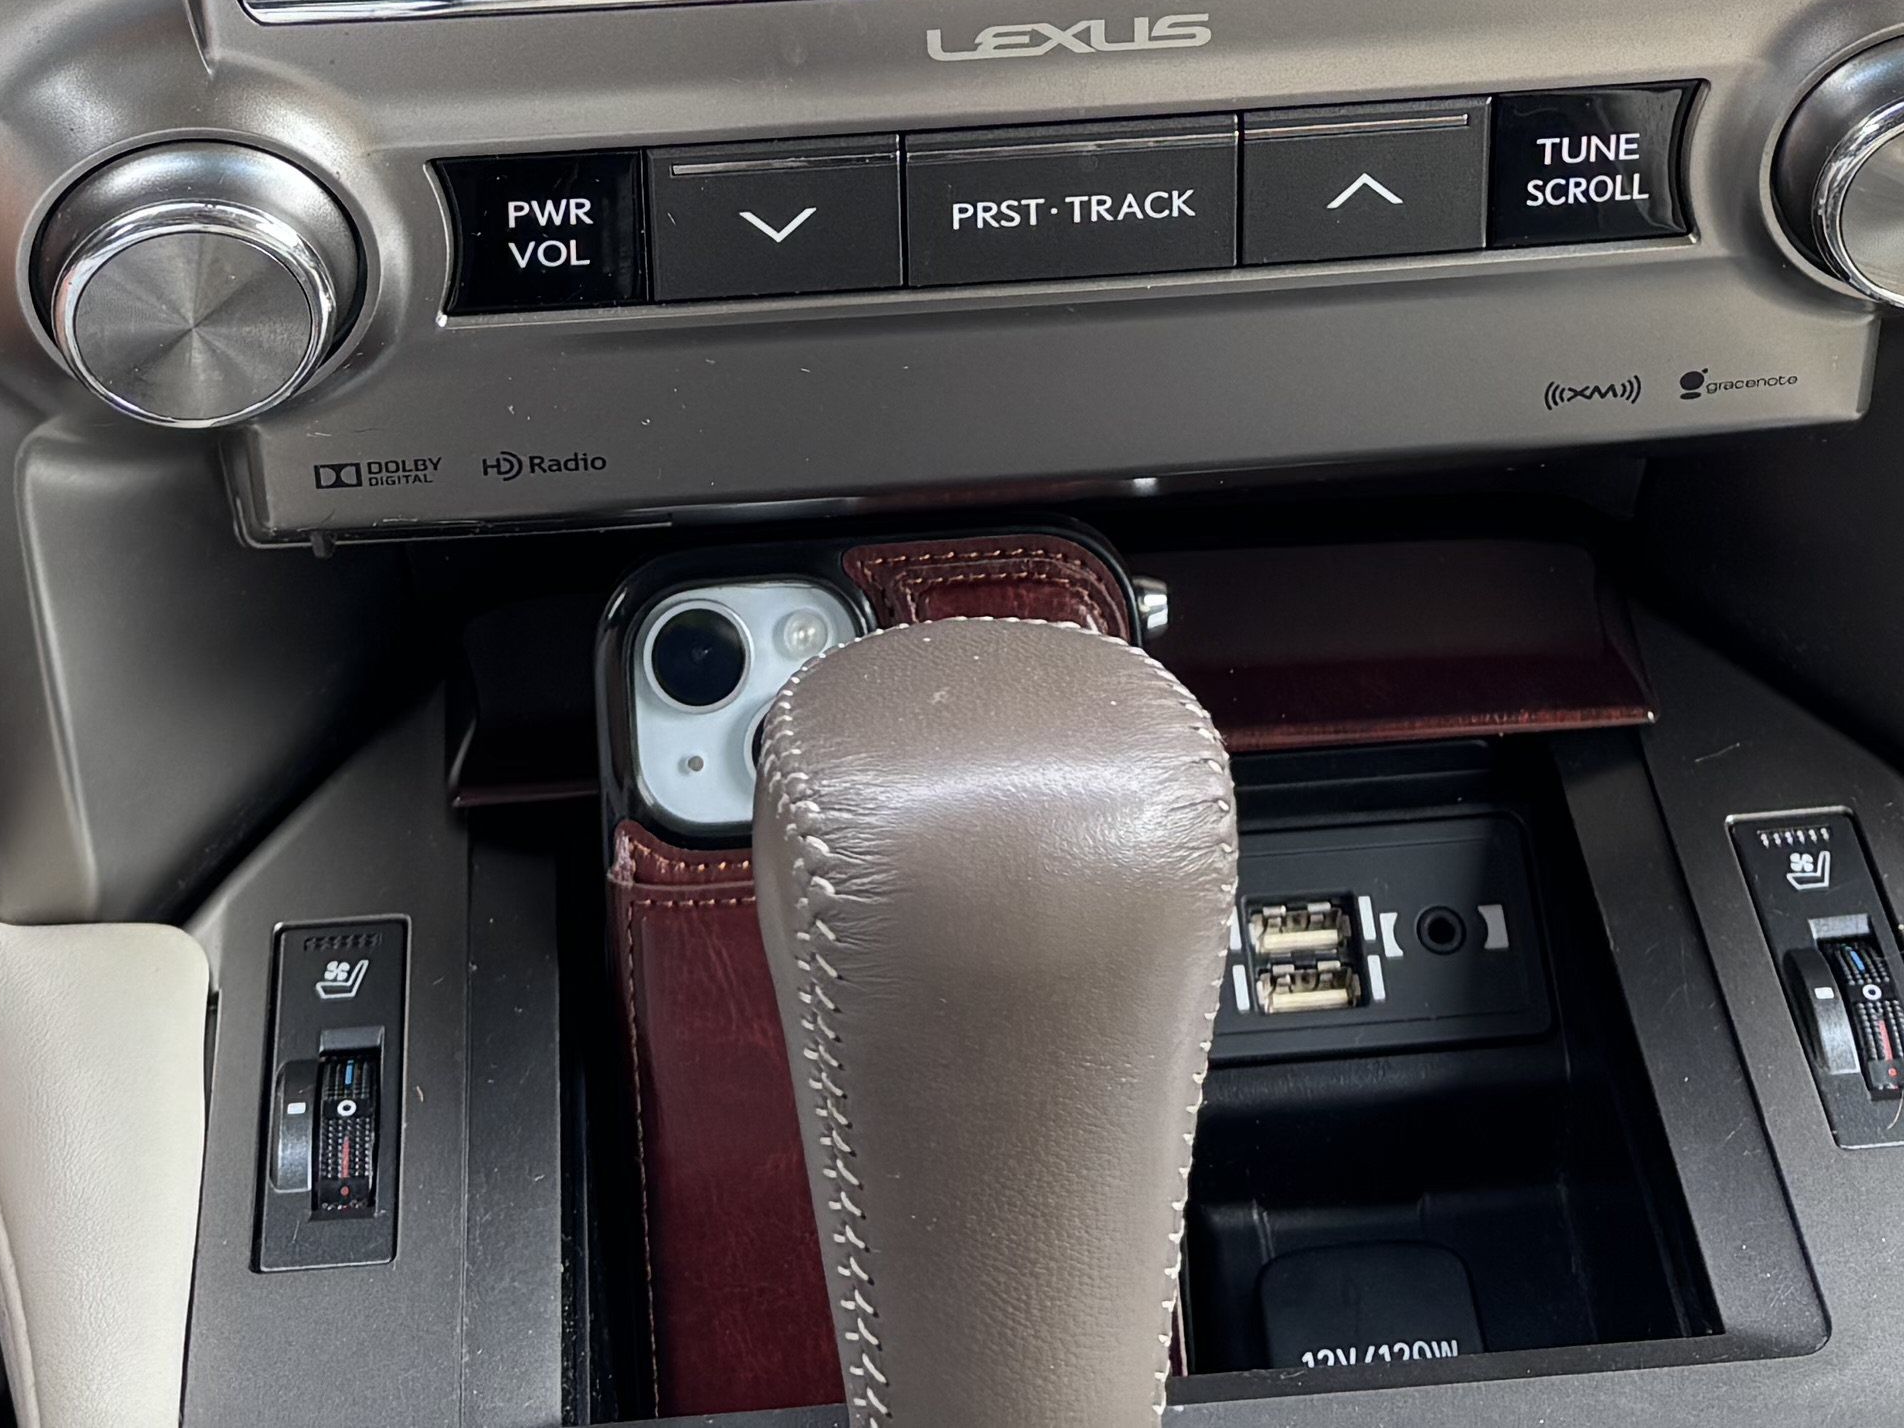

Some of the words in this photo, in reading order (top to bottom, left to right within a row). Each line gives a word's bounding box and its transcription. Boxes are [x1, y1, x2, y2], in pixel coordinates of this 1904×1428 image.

[926, 12, 1212, 62] LEXUS
[1536, 132, 1641, 167] TUNE
[1525, 172, 1650, 207] SCROLL
[507, 197, 594, 229] PWR
[508, 238, 591, 269] VOL
[1705, 375, 1798, 395] gracenote
[366, 456, 443, 476] DOLBY
[528, 452, 607, 475] Radio
[368, 473, 434, 488] DIGITAL
